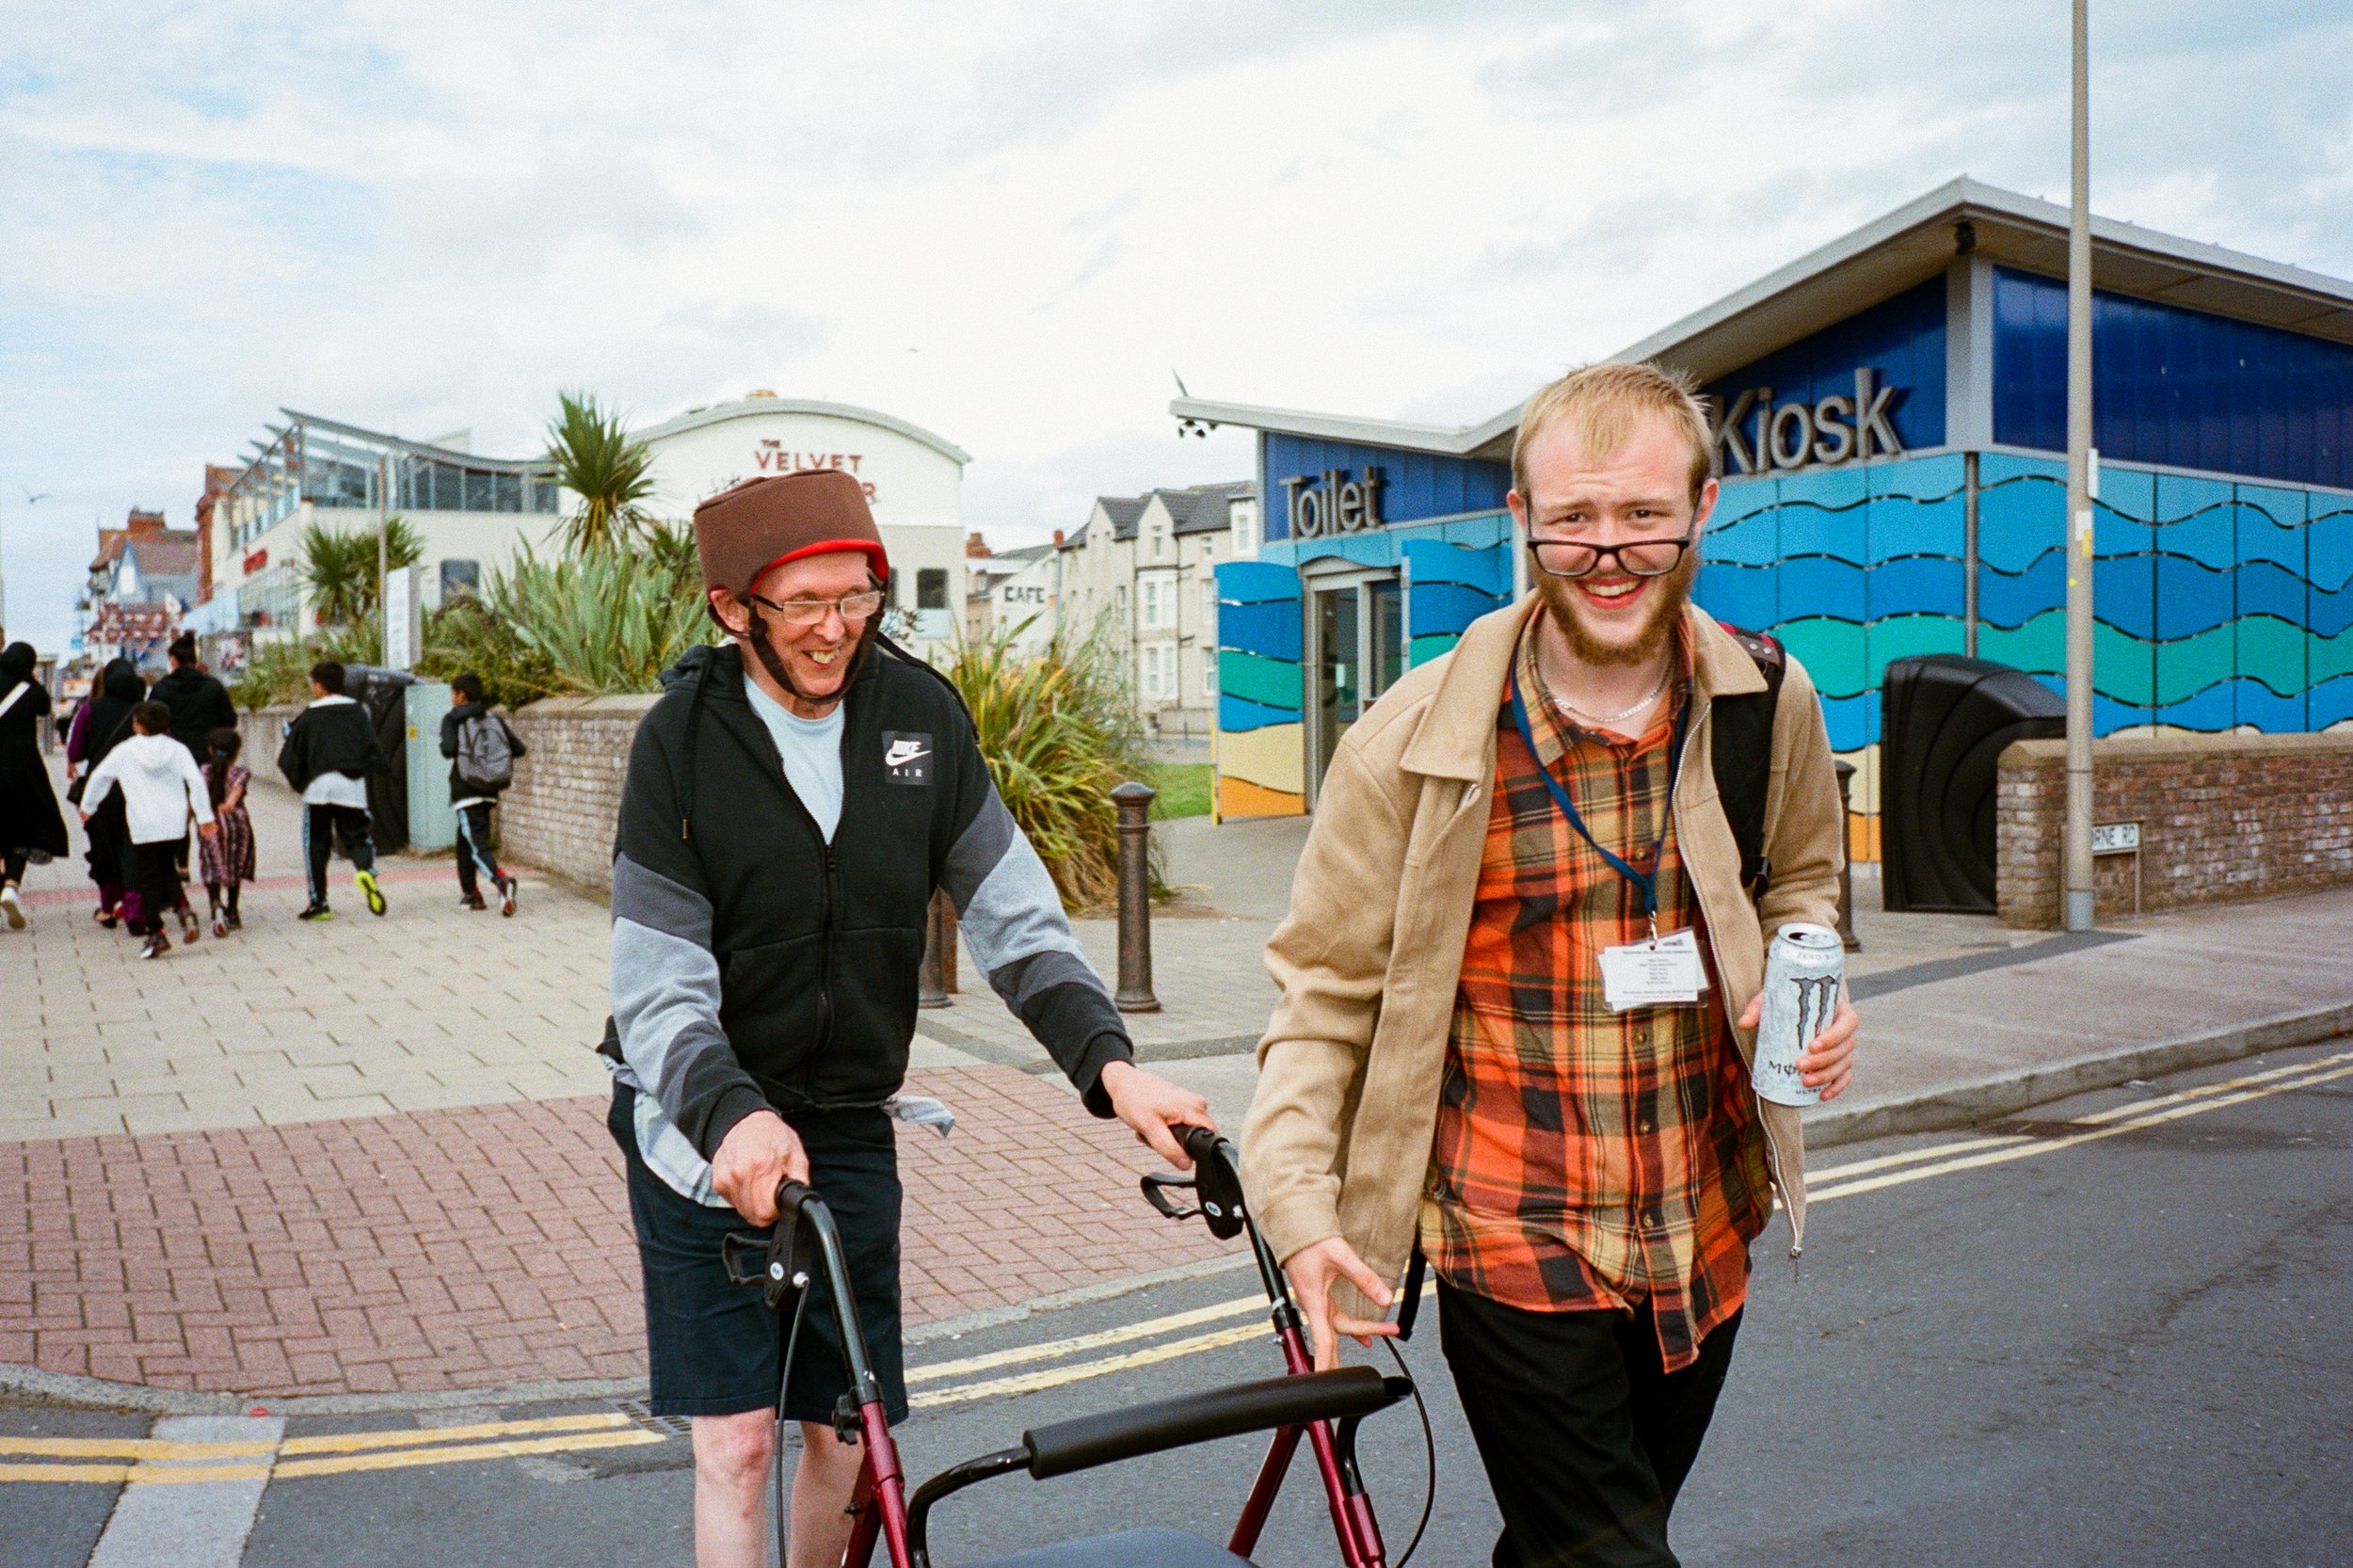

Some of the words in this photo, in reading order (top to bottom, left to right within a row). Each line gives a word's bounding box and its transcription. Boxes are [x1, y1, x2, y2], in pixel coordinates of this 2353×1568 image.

[1708, 366, 1903, 479] Kiosk
[760, 439, 781, 448] THE
[755, 450, 863, 472] VELVET
[1278, 466, 1382, 541] Toilet
[1004, 586, 1045, 603] CAFE
[892, 768, 922, 777] AIR
[2091, 826, 2116, 846] RNE
[2121, 824, 2136, 844] RD
